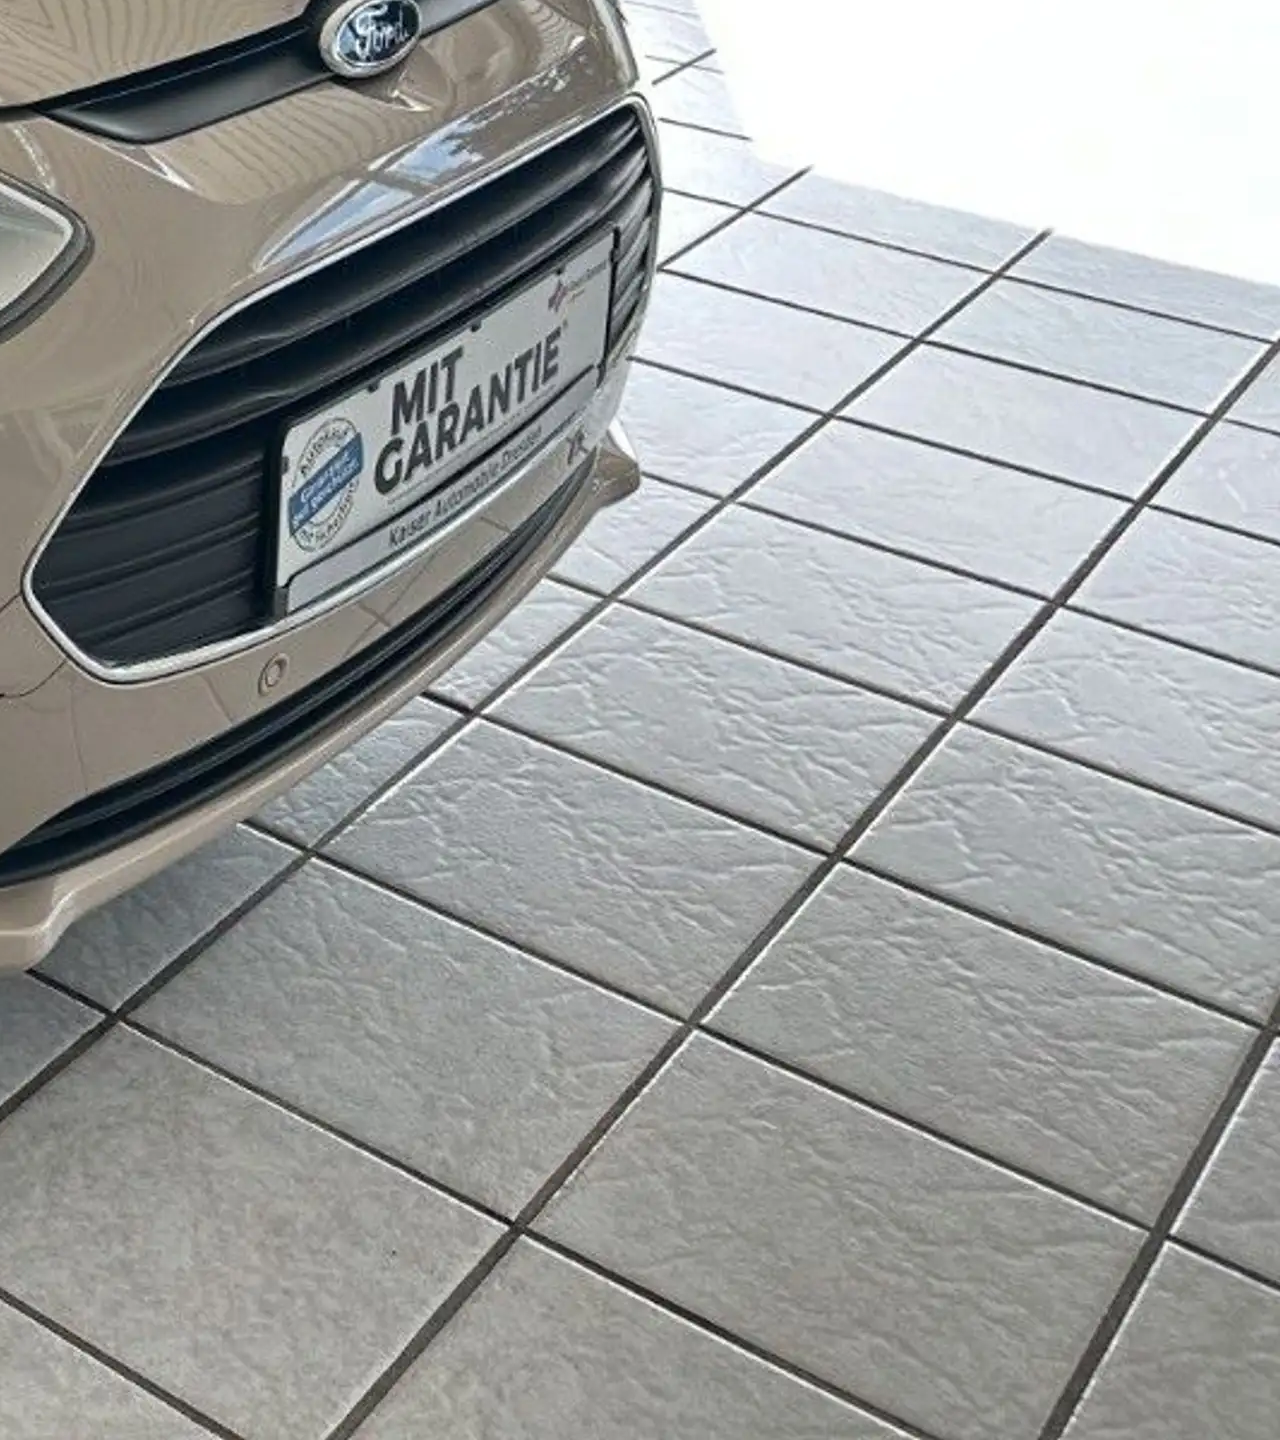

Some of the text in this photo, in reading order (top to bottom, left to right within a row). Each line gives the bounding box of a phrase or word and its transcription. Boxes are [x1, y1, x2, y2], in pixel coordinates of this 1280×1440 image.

[355, 3, 410, 61] Ford
[374, 326, 562, 495] GARANTIE
[392, 346, 463, 435] MIT
